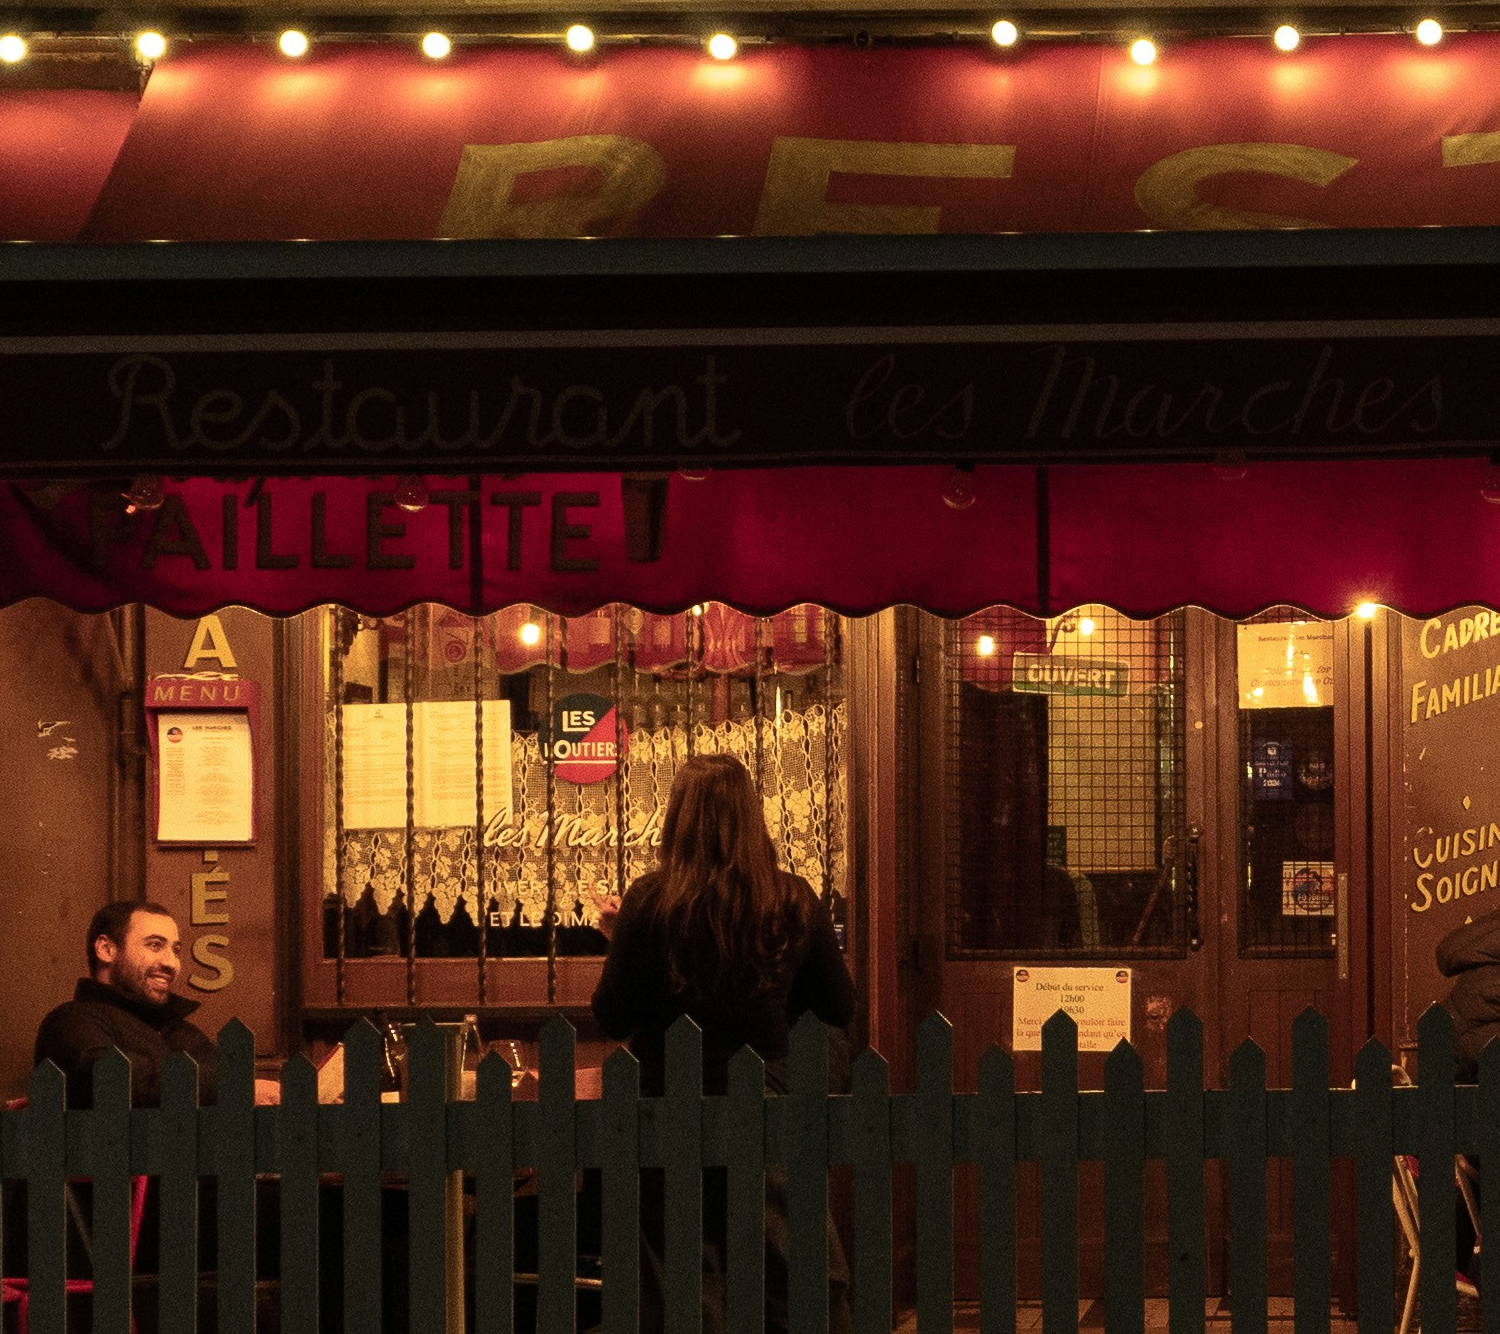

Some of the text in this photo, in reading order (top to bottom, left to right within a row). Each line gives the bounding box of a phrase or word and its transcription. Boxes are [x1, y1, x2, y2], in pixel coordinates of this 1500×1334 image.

[101, 343, 1444, 453] Restaurant les Marches
[1028, 664, 1117, 689] OUVERT
[154, 685, 241, 702] MENU
[562, 710, 595, 732] LES
[544, 740, 618, 759] OUTIER
[1036, 982, 1104, 991] Début du service
[1060, 994, 1085, 1003] 12h00
[1061, 1006, 1085, 1014] 9h30
[1019, 1017, 1042, 1025] Merci
